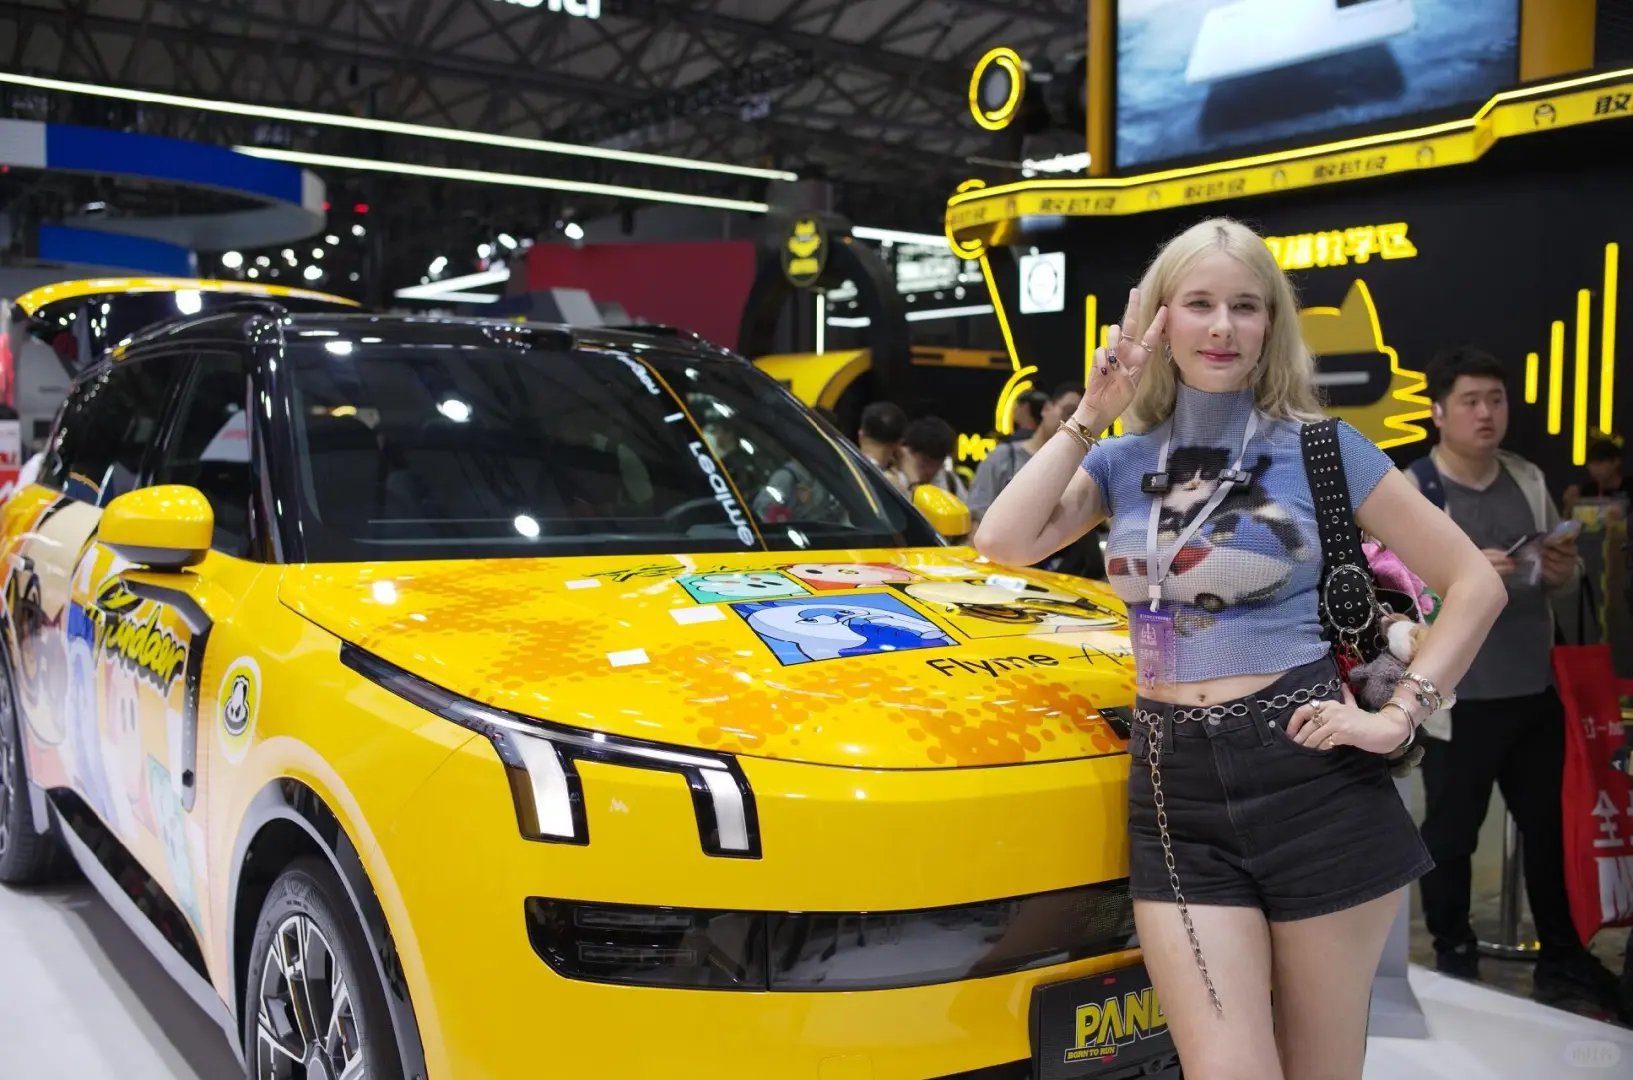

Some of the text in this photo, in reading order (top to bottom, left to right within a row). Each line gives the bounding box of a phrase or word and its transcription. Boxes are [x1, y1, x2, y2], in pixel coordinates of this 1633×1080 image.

[925, 653, 1060, 678] Flyme
[1088, 1048, 1099, 1057] TO
[1100, 1046, 1116, 1056] RUN
